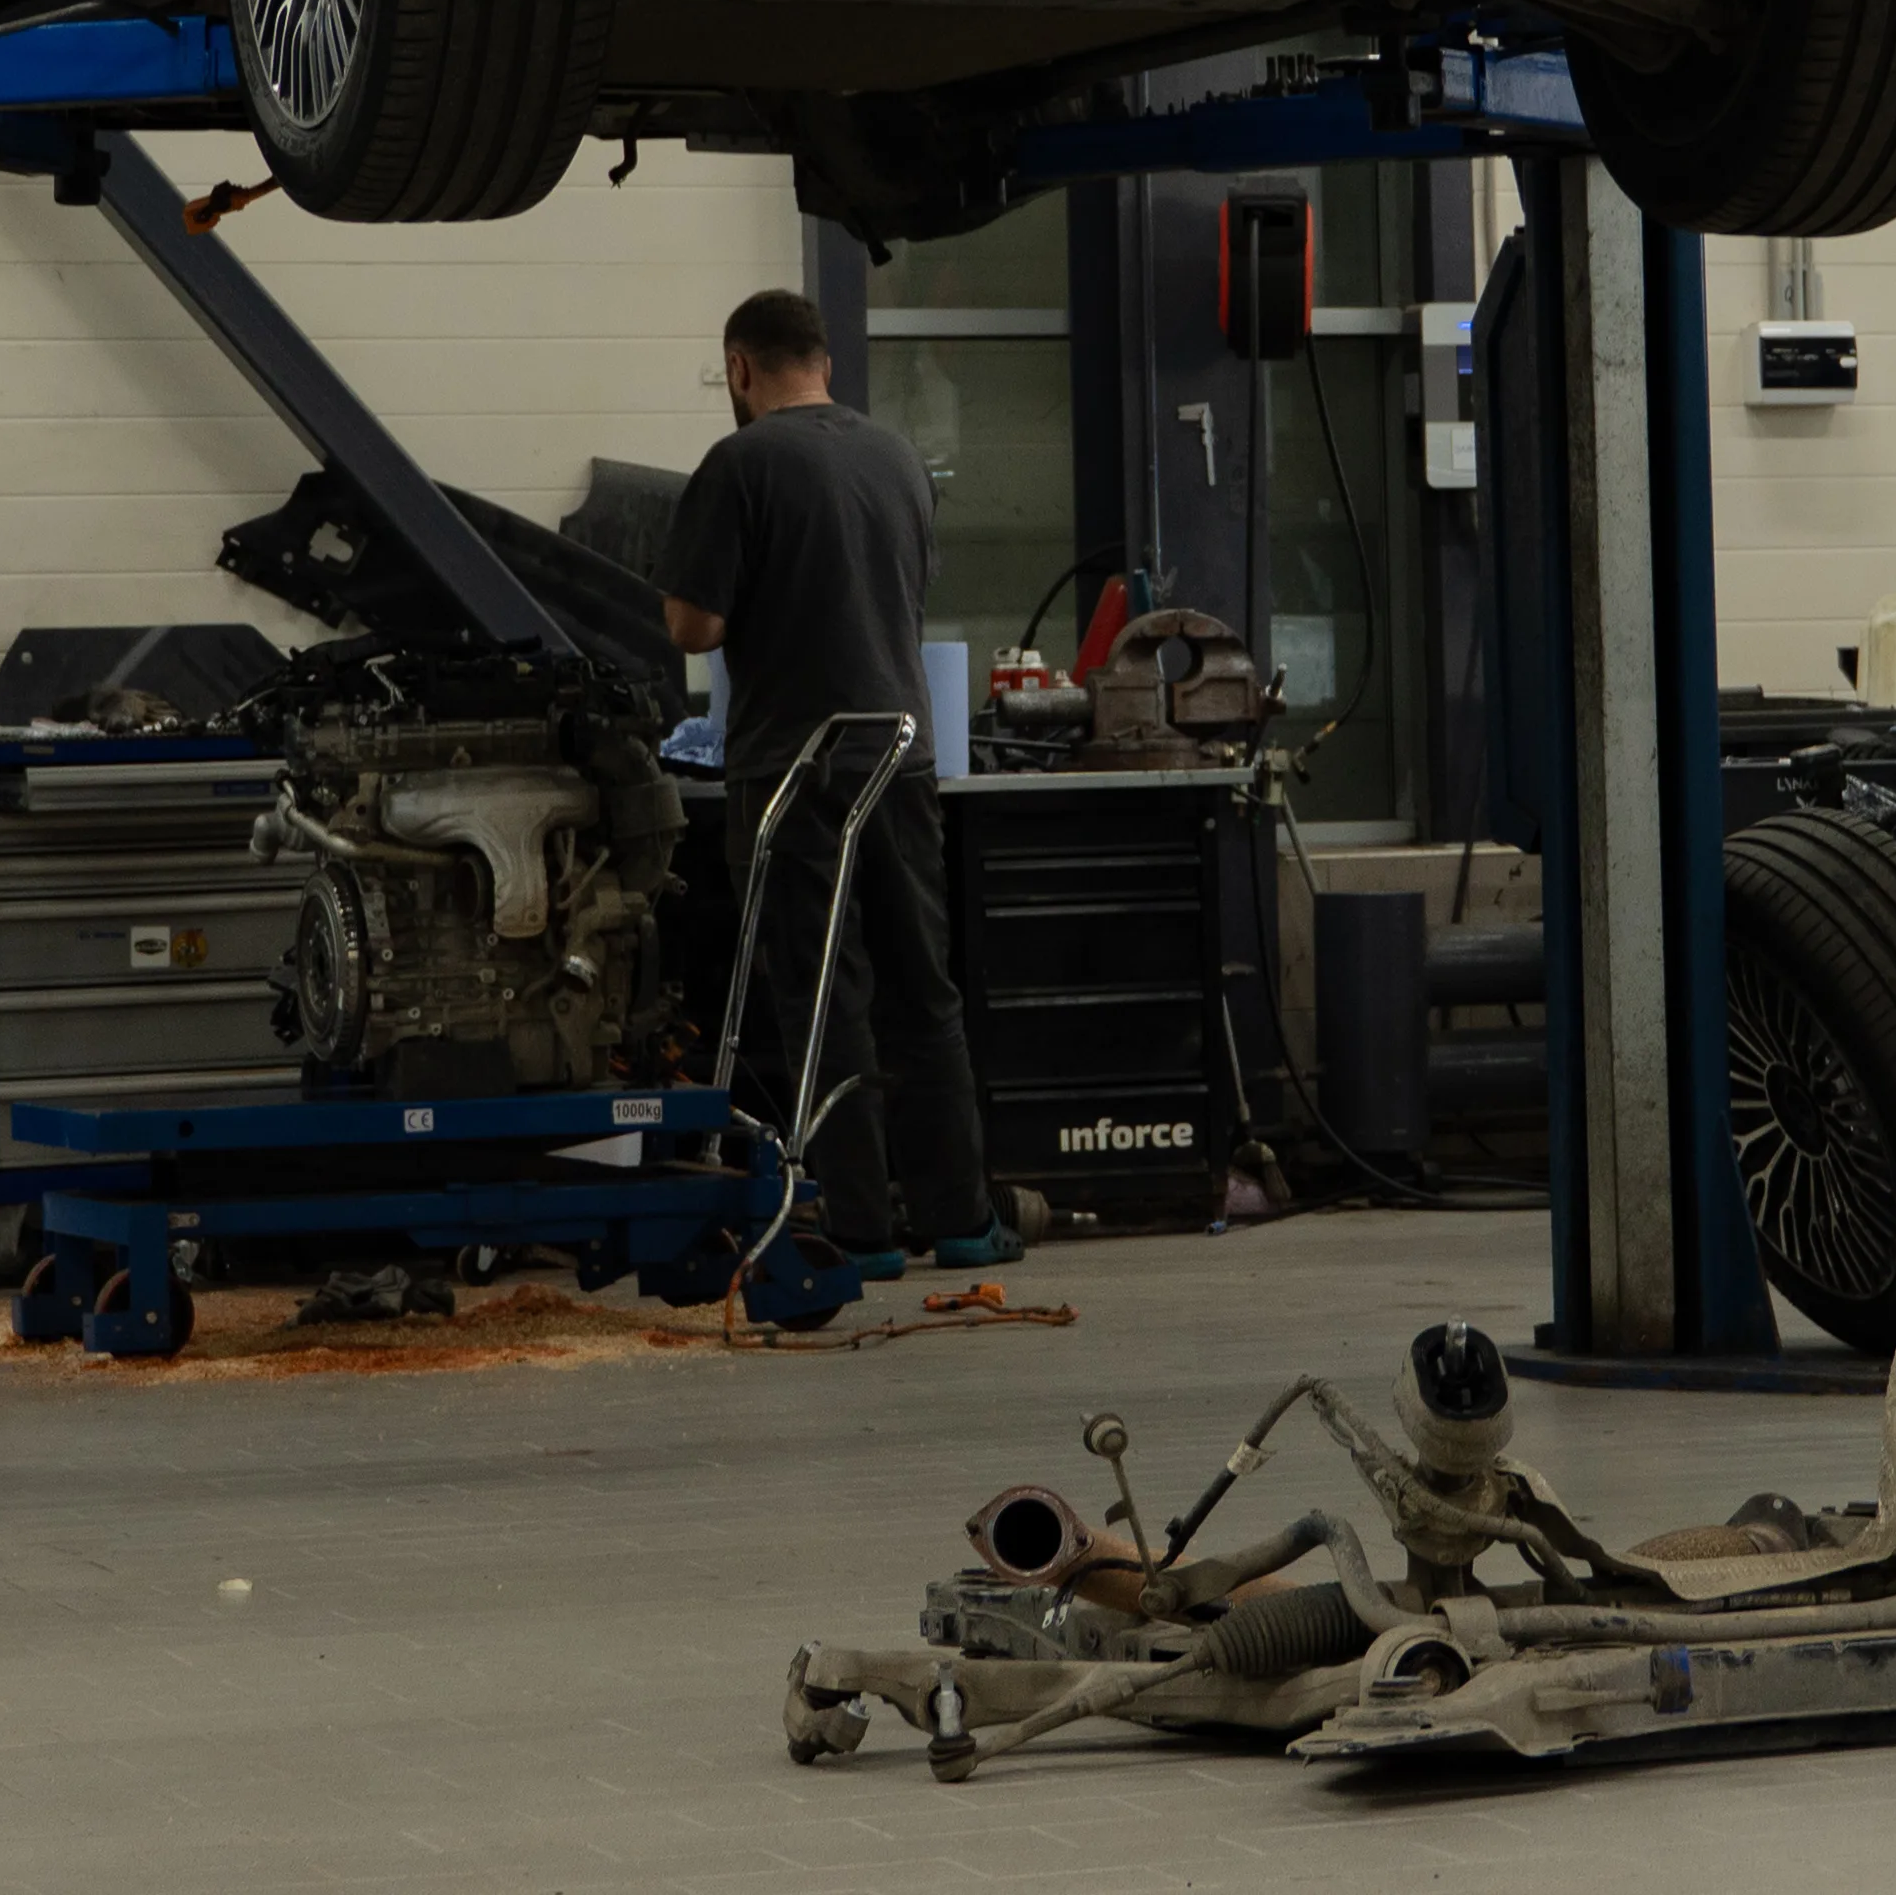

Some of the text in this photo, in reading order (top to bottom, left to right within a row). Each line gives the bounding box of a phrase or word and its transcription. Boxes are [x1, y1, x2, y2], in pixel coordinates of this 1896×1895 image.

[407, 1111, 430, 1130] CE
[614, 1102, 662, 1120] 1000kg
[1059, 1116, 1194, 1152] inforce
